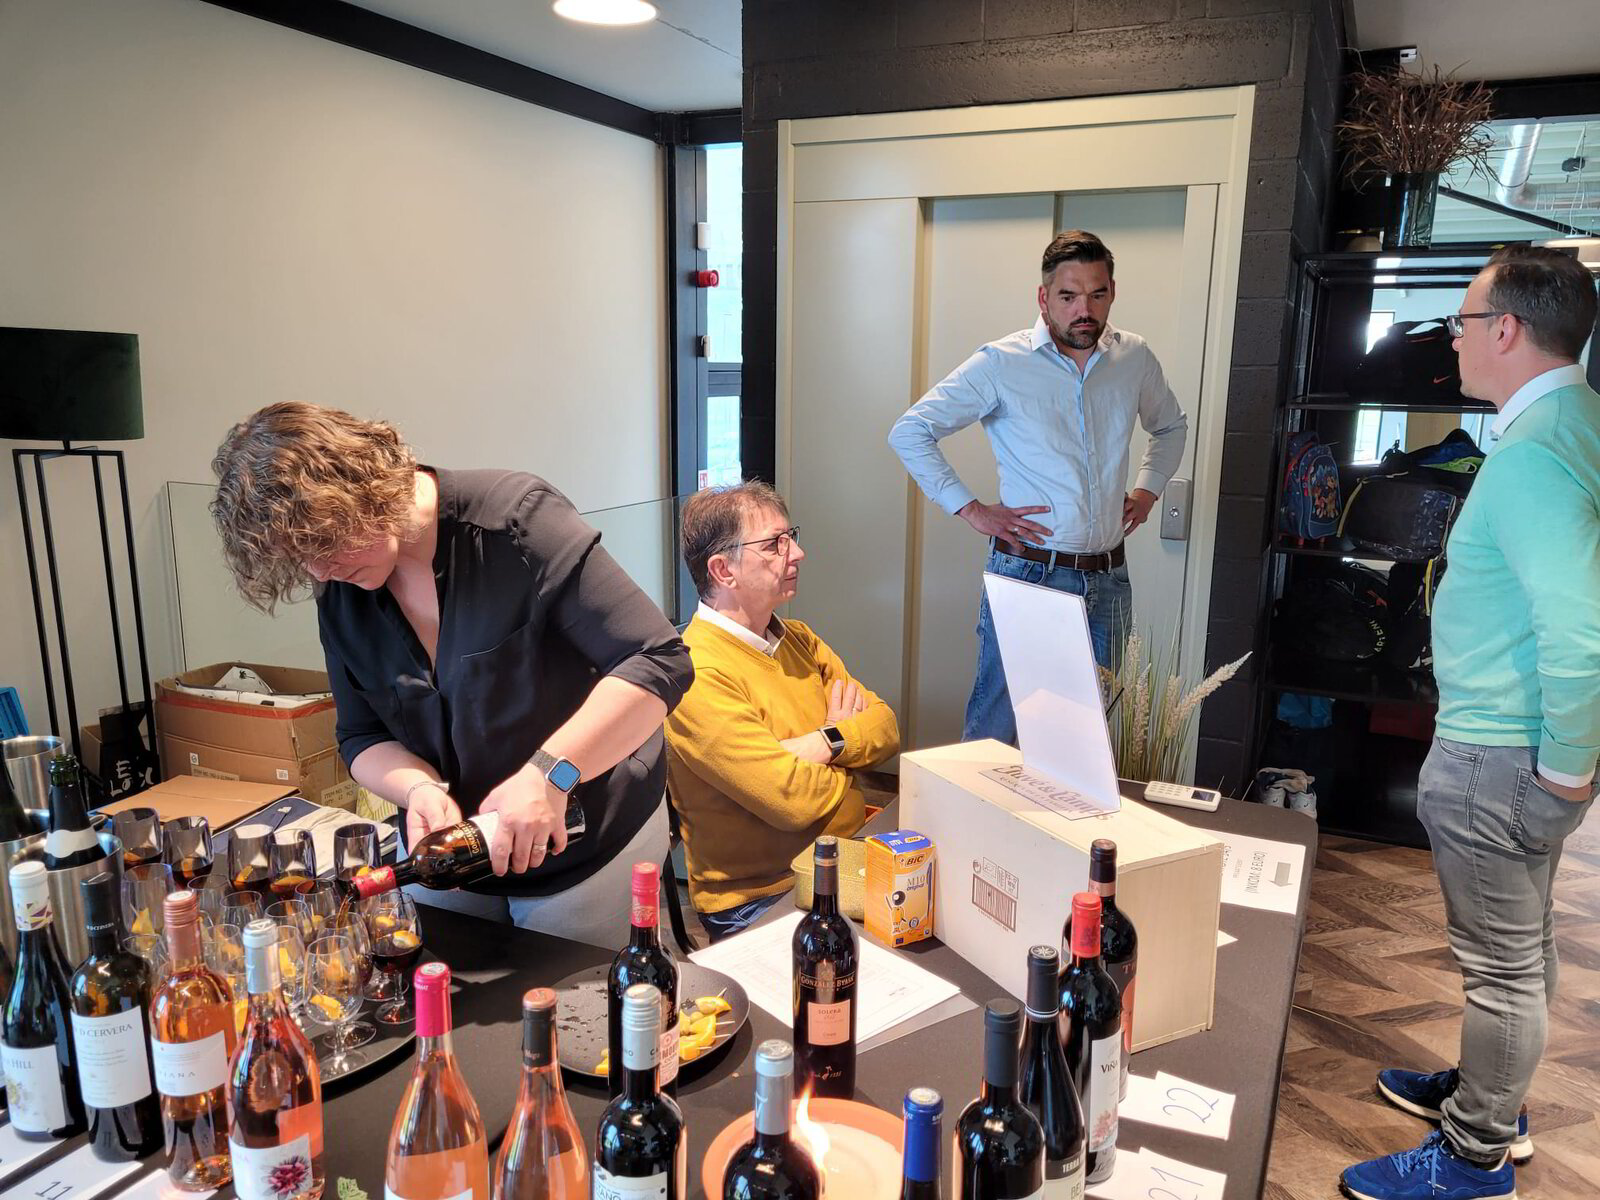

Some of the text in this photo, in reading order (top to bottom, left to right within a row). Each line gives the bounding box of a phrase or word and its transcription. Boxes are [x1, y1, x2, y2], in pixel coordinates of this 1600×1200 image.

[906, 854, 925, 867] BIC
[1162, 1087, 1220, 1124] 22
[34, 1180, 74, 1200] 11
